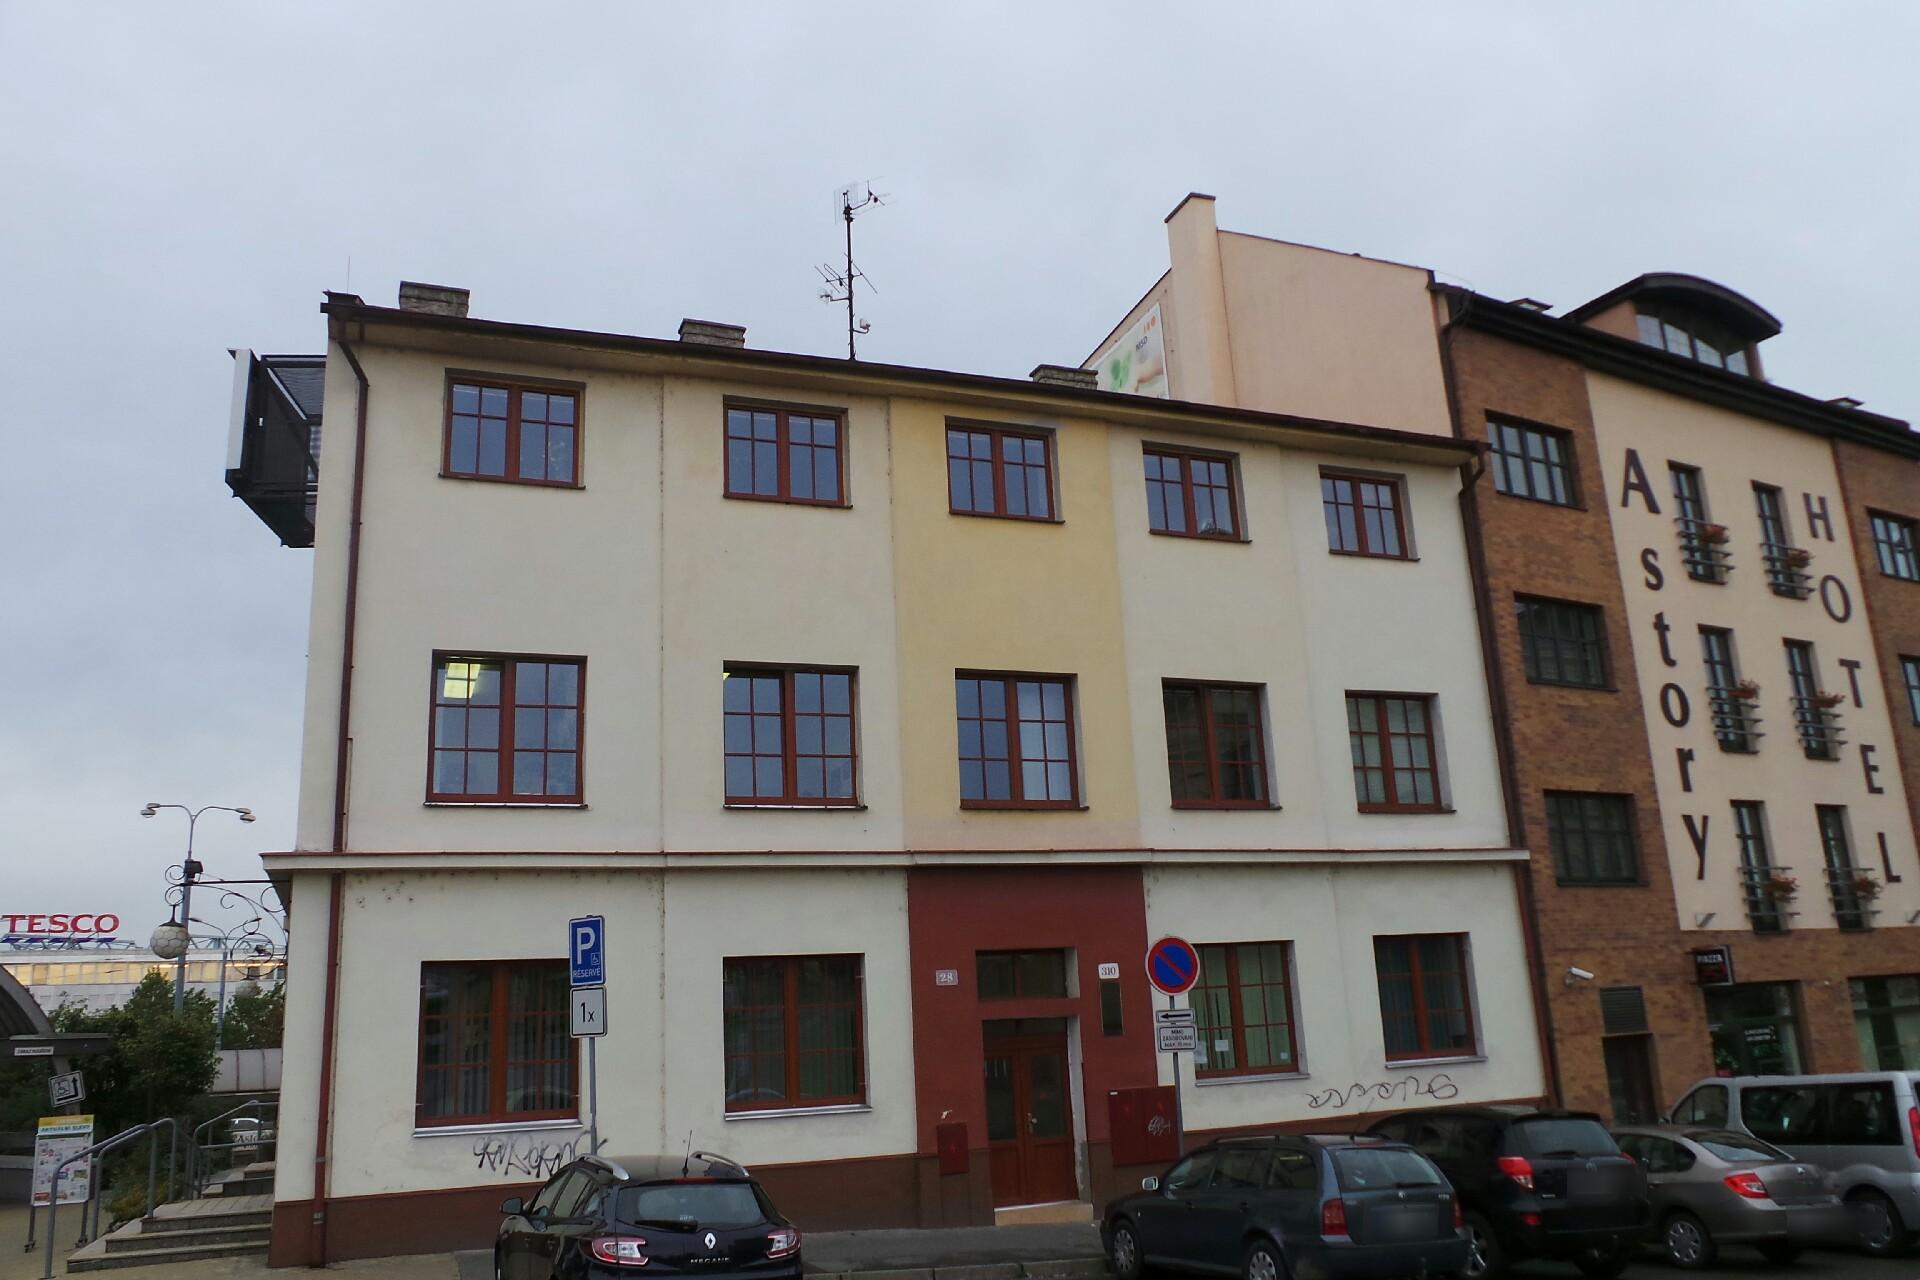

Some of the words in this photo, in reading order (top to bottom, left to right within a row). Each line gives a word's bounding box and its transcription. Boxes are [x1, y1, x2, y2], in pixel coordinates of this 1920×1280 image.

[1621, 448, 1709, 880] Astory
[1803, 492, 1902, 884] HOTEL
[2, 914, 120, 933] TESCO
[576, 927, 596, 965] P
[940, 972, 953, 982] 28
[580, 1002, 595, 1023] 1x
